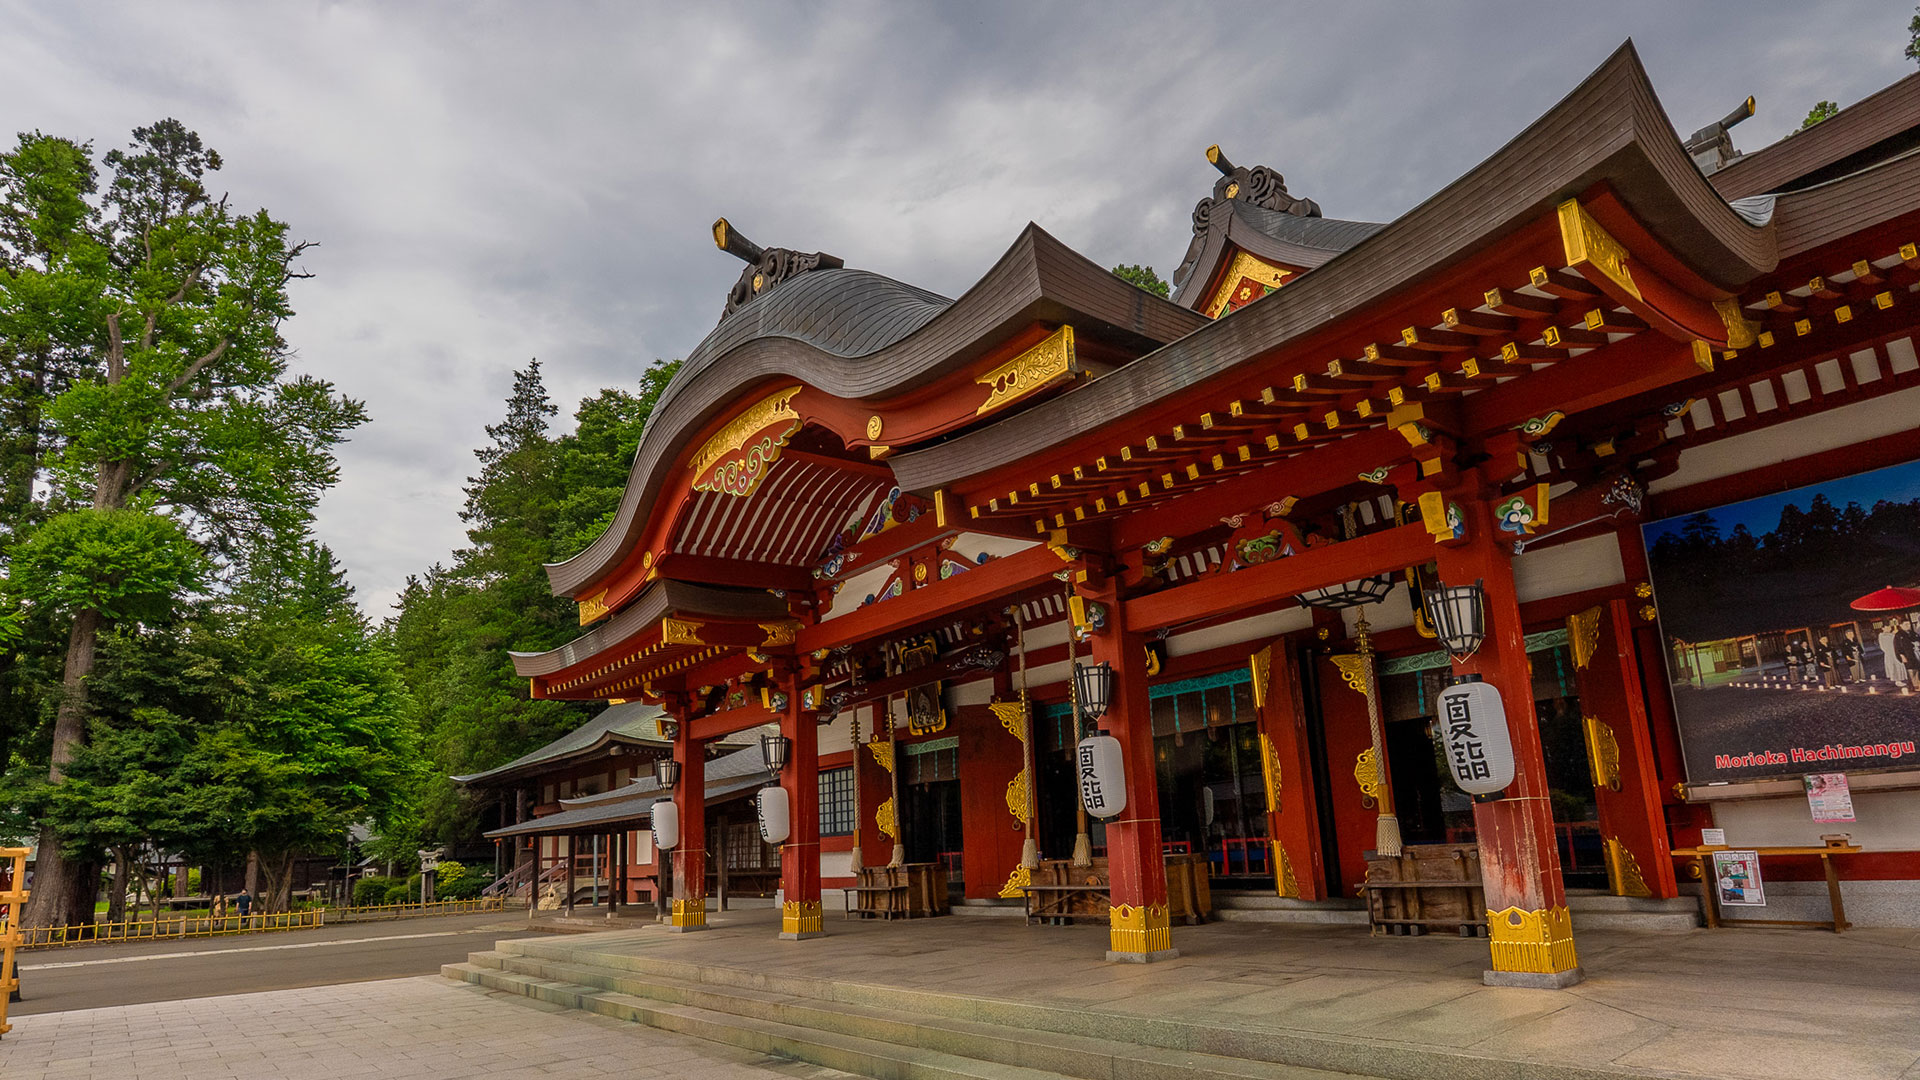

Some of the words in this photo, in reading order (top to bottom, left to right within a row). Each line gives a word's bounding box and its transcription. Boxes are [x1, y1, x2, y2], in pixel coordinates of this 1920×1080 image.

[1444, 693, 1490, 781] 夏詣
[1715, 752, 1788, 769] Morioka
[1791, 741, 1916, 763] Hachimangu
[1079, 745, 1105, 810] 夏詣
